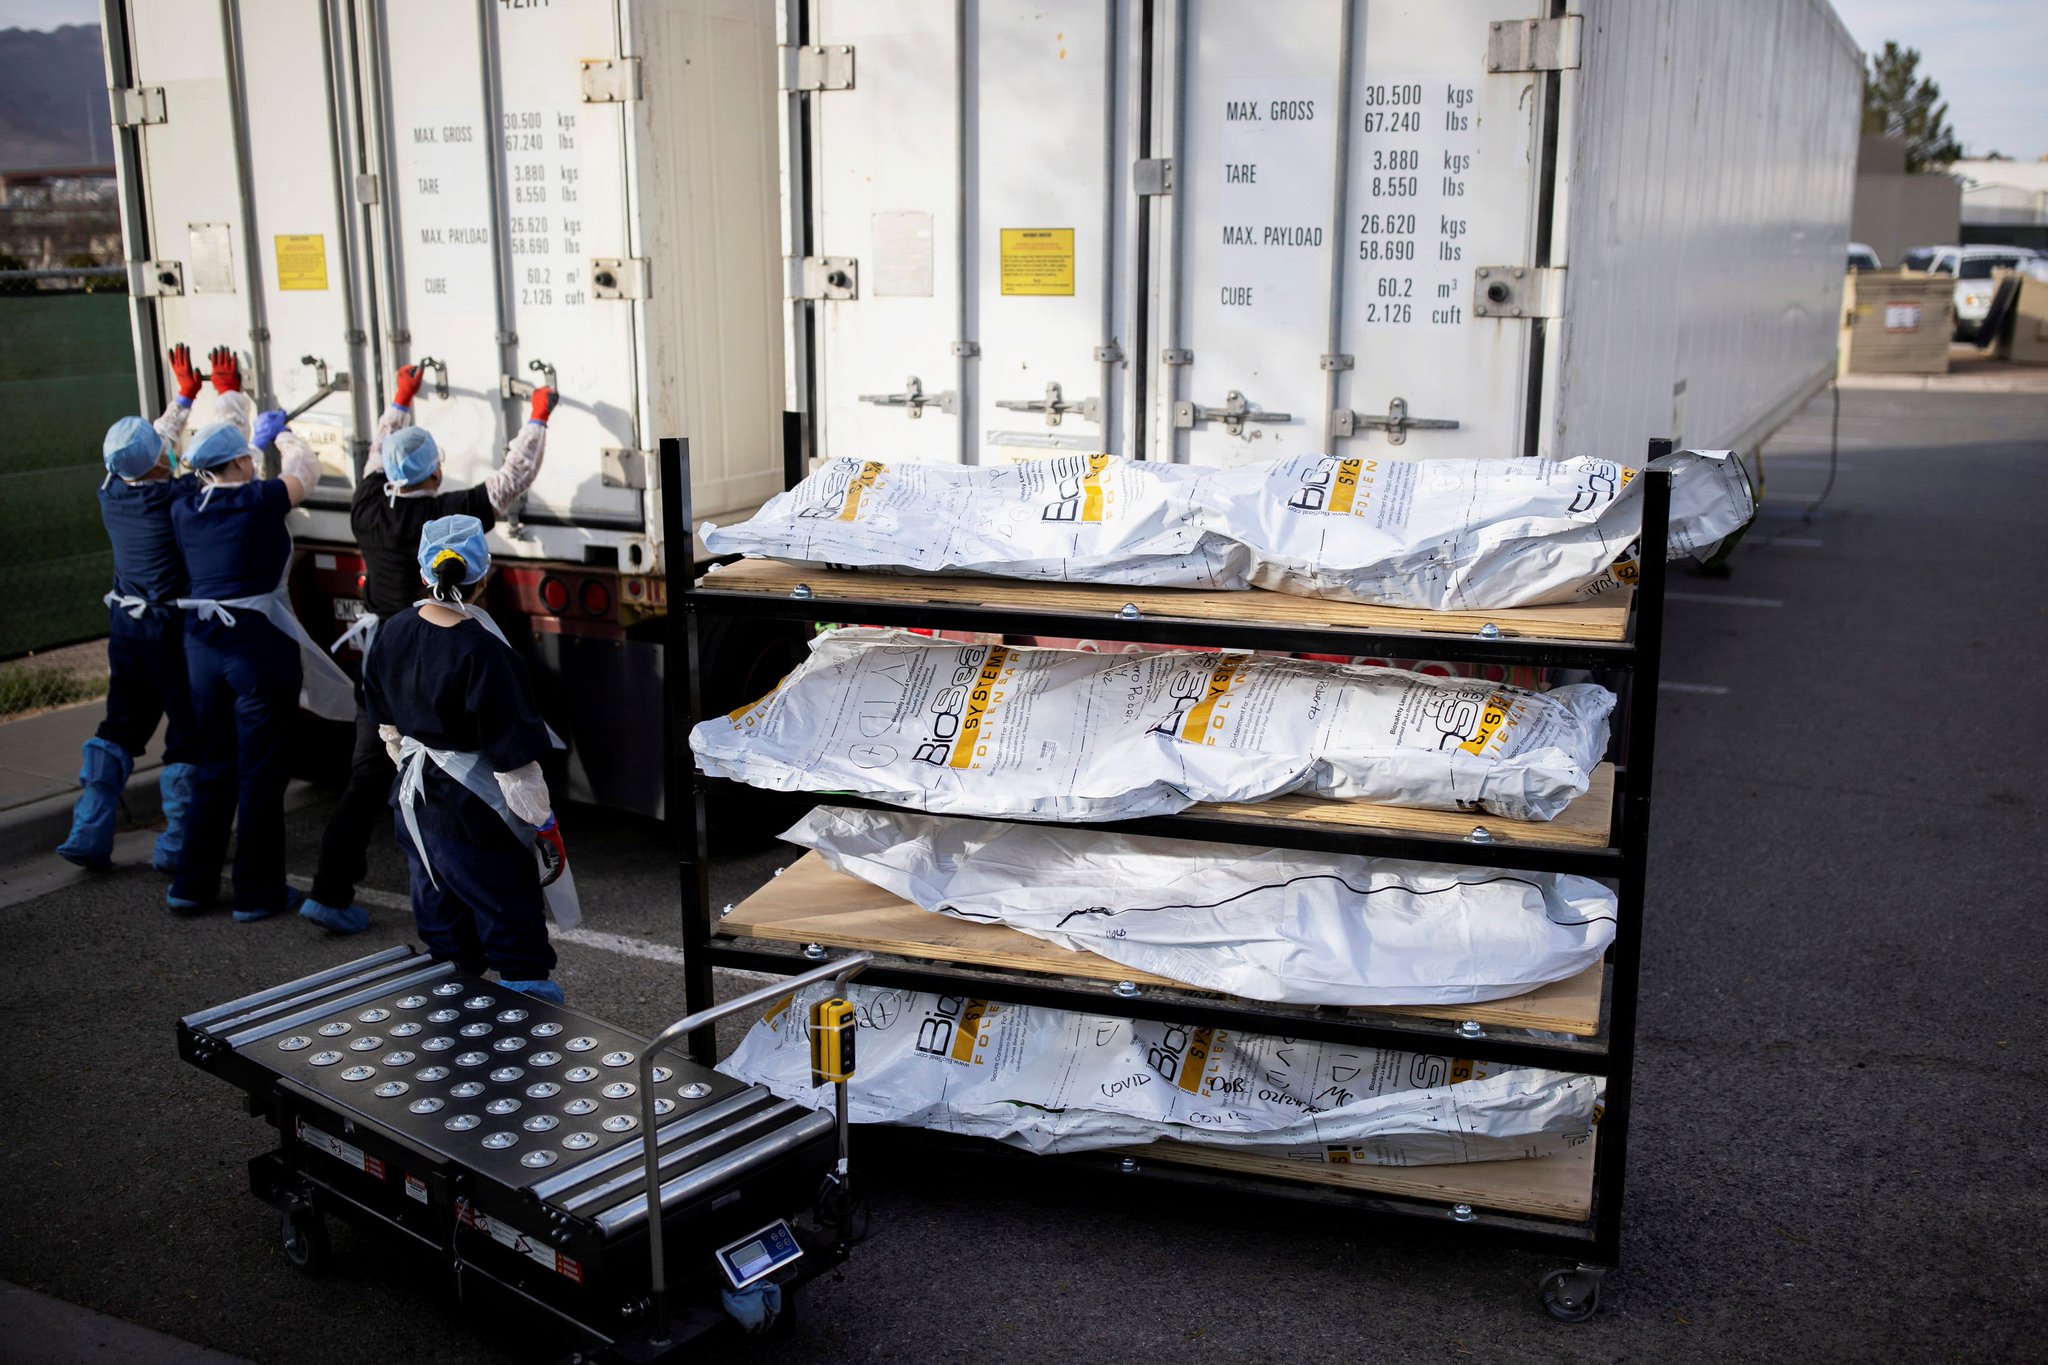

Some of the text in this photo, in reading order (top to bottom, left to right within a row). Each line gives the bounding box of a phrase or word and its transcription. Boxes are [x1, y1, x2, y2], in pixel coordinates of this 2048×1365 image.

[1366, 84, 1473, 106] 30.500 kgs
[558, 112, 576, 129] kgs
[1226, 101, 1314, 121] MAX. GROSS
[1364, 112, 1468, 132] 67.240 lbs
[414, 126, 472, 144] MAX. GROSS
[506, 133, 574, 151] 67.240 lbs
[1374, 151, 1470, 171] 3.880 kgs
[515, 165, 578, 182] 3.880 kgs
[1226, 165, 1256, 183] TARE
[418, 178, 439, 194] TARE
[516, 187, 577, 202] 8.550 lbs
[1372, 176, 1464, 197] 8.550 lbs
[421, 228, 488, 244] MAX. PAYLOAD
[511, 217, 581, 235] 26.620 kgs
[1361, 214, 1466, 238] 26.620 kgs
[564, 238, 580, 254] lbs
[1223, 226, 1322, 247] MAX. PAYLOAD
[1359, 241, 1461, 261] 58.690 lbs
[425, 278, 447, 294] CUBE
[528, 269, 550, 284] 60.2
[566, 290, 585, 305] cuft
[1221, 288, 1252, 306] CUBE
[1378, 278, 1412, 298] 60.2
[1368, 304, 1461, 324] 2.126 cuft
[1339, 459, 1360, 486] SYS
[1355, 460, 1379, 518] FOLIEN
[1307, 680, 1330, 721] Roberto
[1230, 710, 1245, 748] Containment
[1390, 707, 1403, 734] Biosafety
[914, 1050, 970, 1068] www.BioSeal.com
[990, 1062, 999, 1082] Secure
[995, 1026, 1006, 1061] Containment
[1101, 1073, 1152, 1097] COVID
[1369, 1066, 1379, 1090] Biosafety
